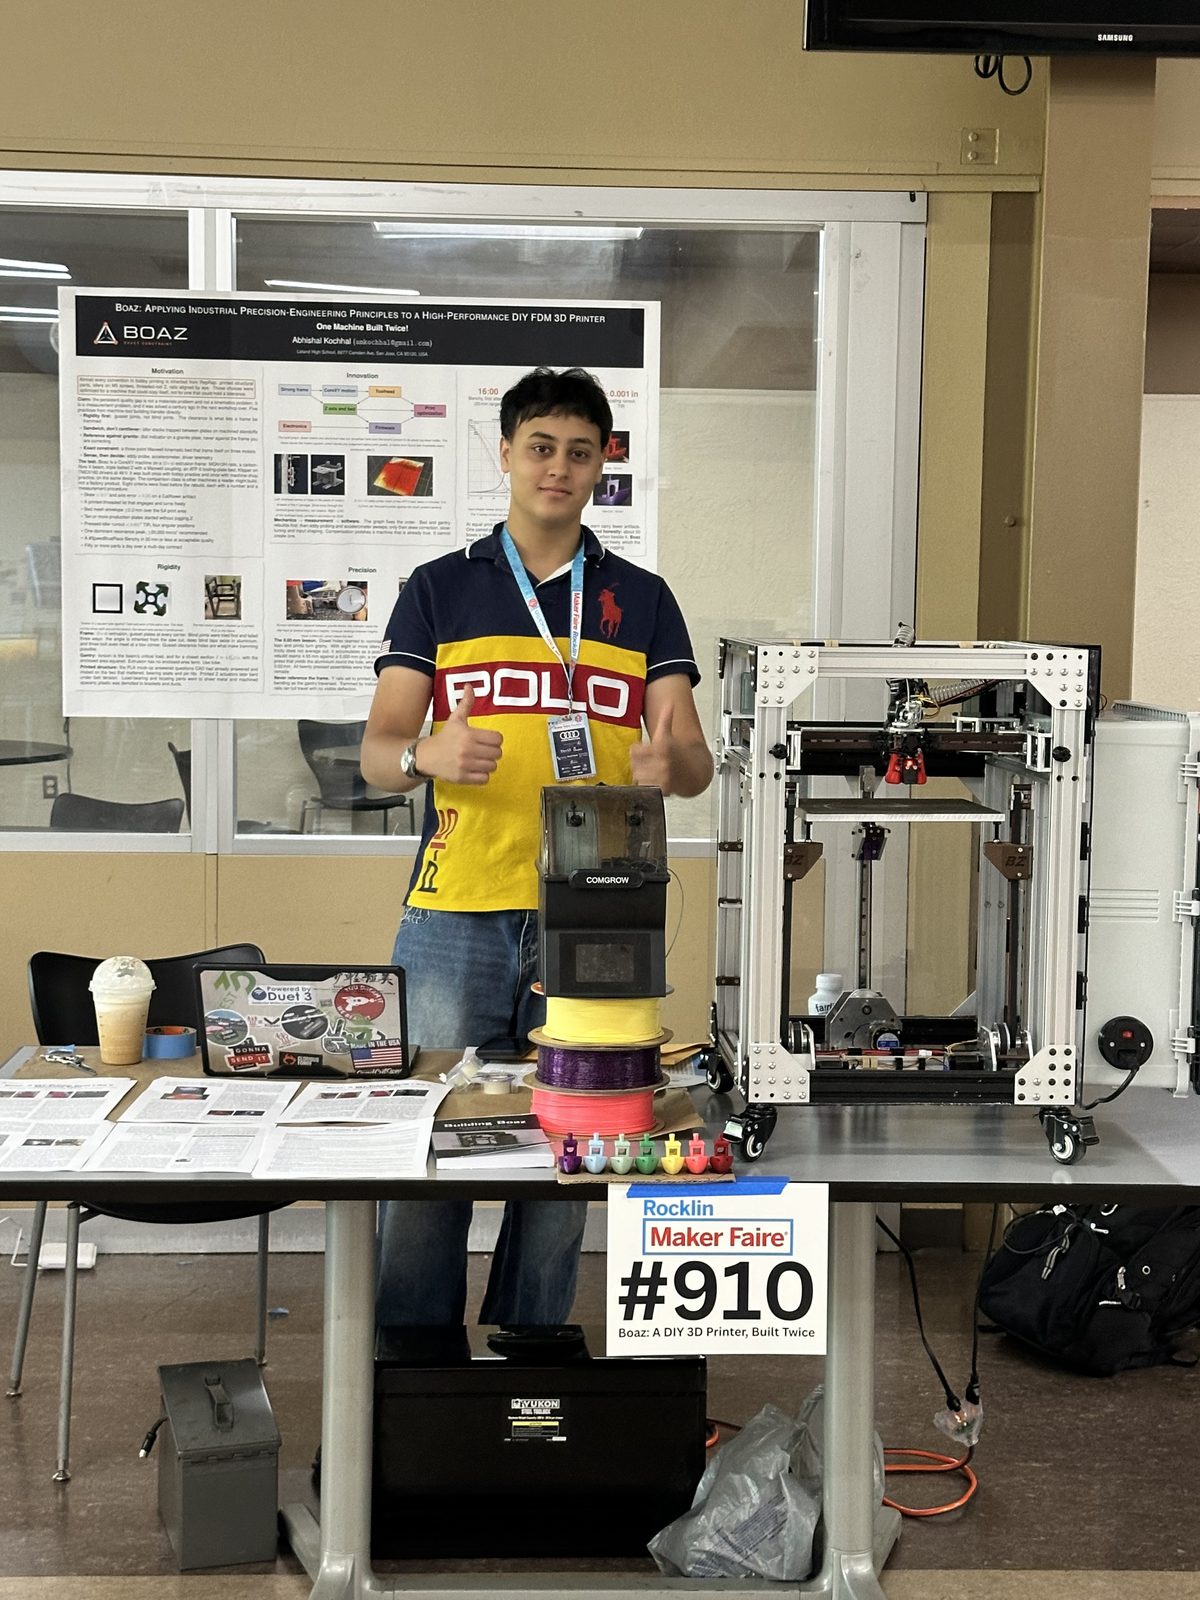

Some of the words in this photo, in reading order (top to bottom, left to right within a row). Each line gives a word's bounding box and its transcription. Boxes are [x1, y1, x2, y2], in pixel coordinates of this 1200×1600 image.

[512, 312, 528, 321] DIY
[531, 313, 552, 322] FDM
[554, 314, 567, 322] 3D
[124, 326, 188, 340] BOAZ
[446, 668, 629, 718] POLO
[268, 992, 300, 1001] Duet
[304, 992, 312, 1001] 3
[644, 1200, 714, 1216] Rocklin
[651, 1227, 723, 1246] Maker
[618, 1261, 813, 1320] #910
[618, 1328, 650, 1338] Boaz:
[652, 1328, 661, 1337] A
[664, 1328, 684, 1337] DIY
[687, 1328, 703, 1337] 3D
[706, 1327, 748, 1338] Printer,
[752, 1327, 780, 1337] Built
[782, 1327, 815, 1337] Twice
